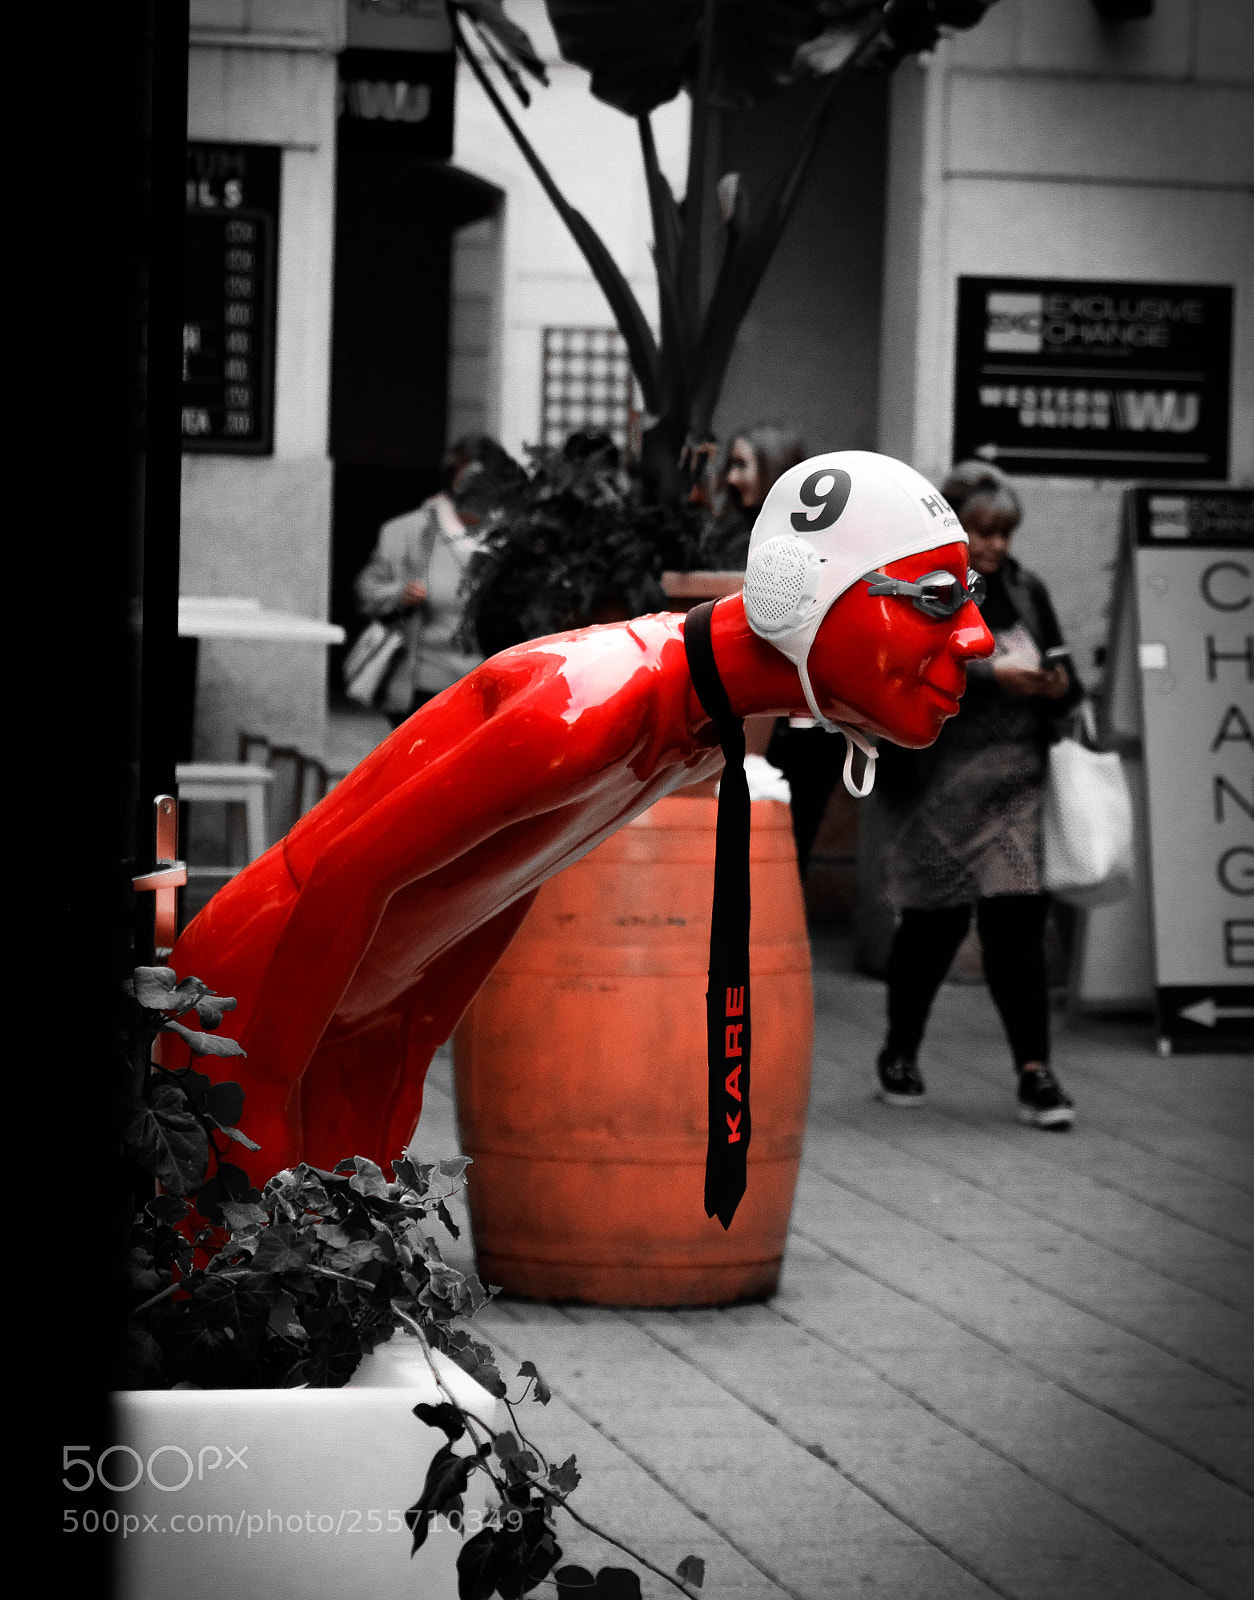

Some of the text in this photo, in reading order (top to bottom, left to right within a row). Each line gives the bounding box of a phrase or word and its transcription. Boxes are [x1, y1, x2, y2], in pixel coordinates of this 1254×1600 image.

[1045, 294, 1204, 324] EXCLUSIVE
[1043, 320, 1170, 348] CHANGE
[790, 468, 852, 533] 9
[724, 985, 745, 1144] KARE
